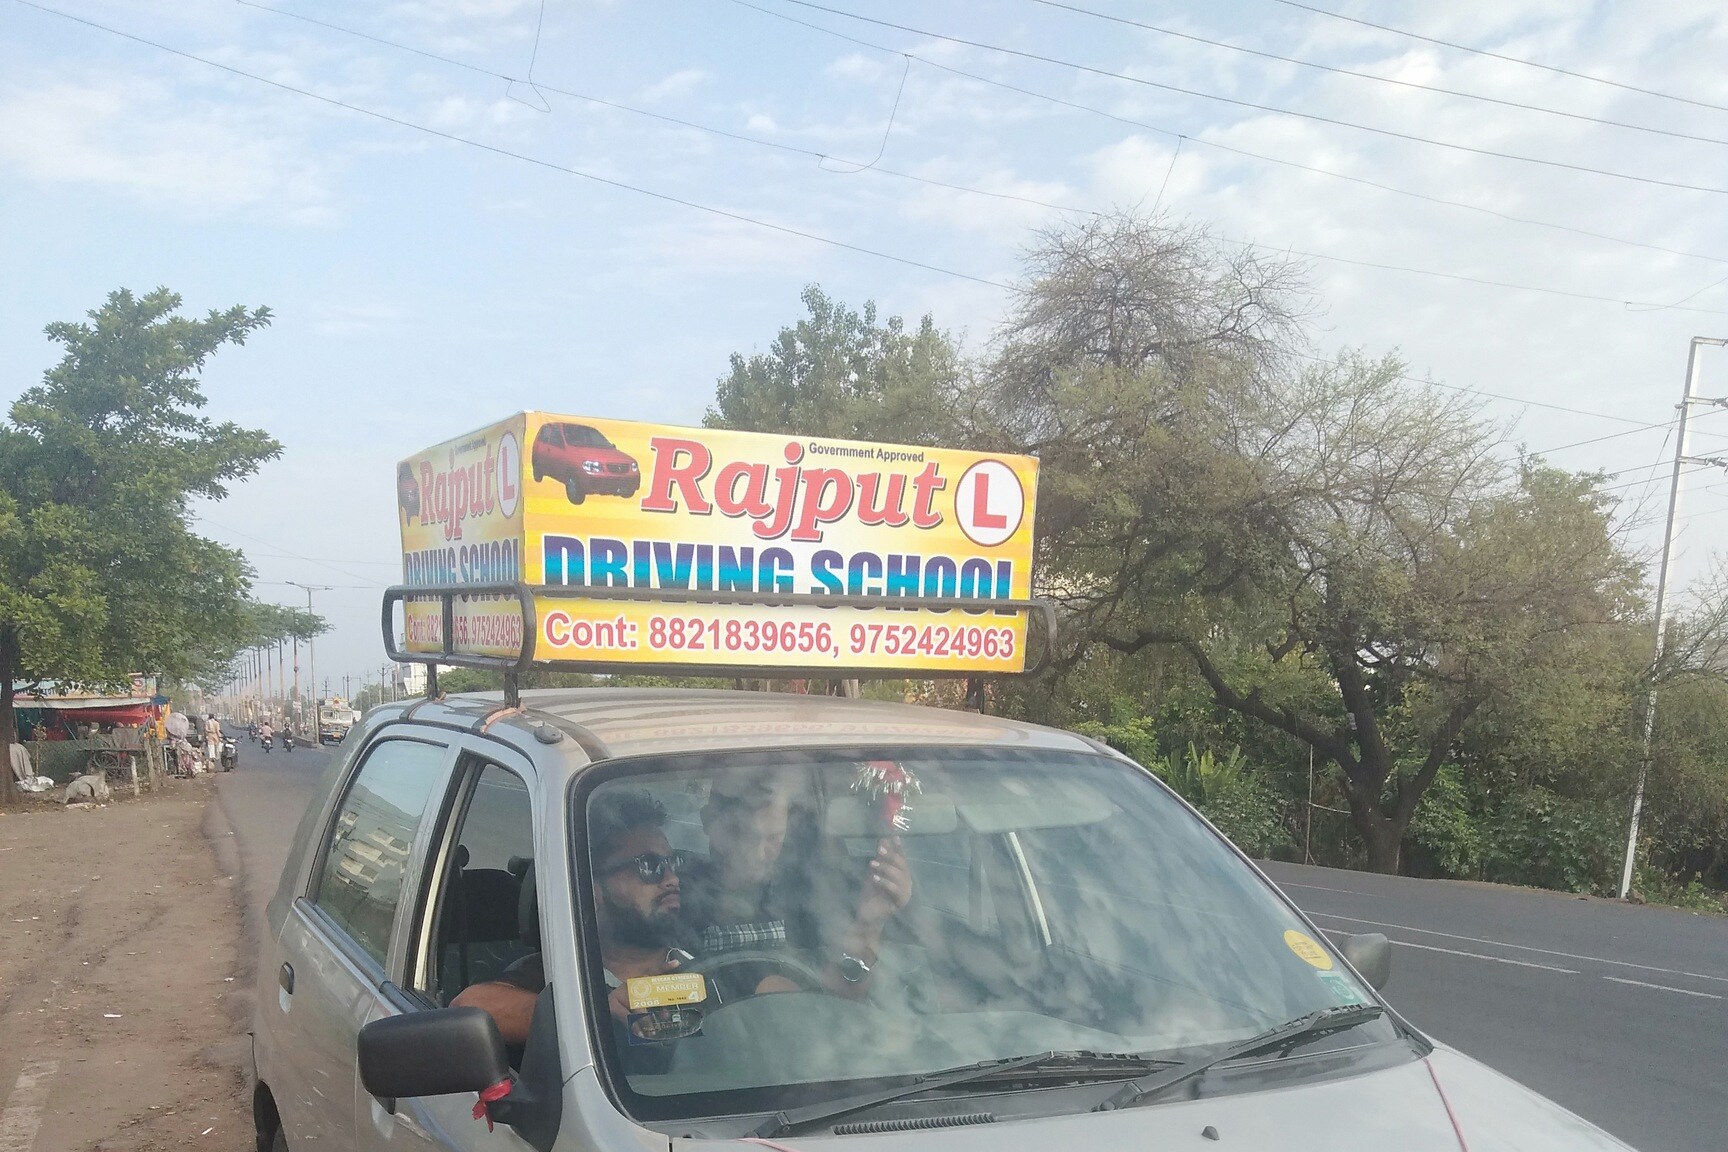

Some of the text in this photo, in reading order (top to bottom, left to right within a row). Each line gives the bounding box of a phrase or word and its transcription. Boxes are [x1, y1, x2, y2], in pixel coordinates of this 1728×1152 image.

[501, 446, 515, 501] L
[876, 448, 924, 463] Approved
[420, 443, 494, 541] Rajput
[641, 437, 947, 542] Rajput
[973, 472, 1007, 529] L
[405, 538, 520, 603] DRIVING SCHOOL
[544, 535, 1018, 616] DRIVING SCHOOL
[472, 615, 521, 648] 9752424963
[546, 613, 1014, 658] Cont: 8821839656, 9752424963
